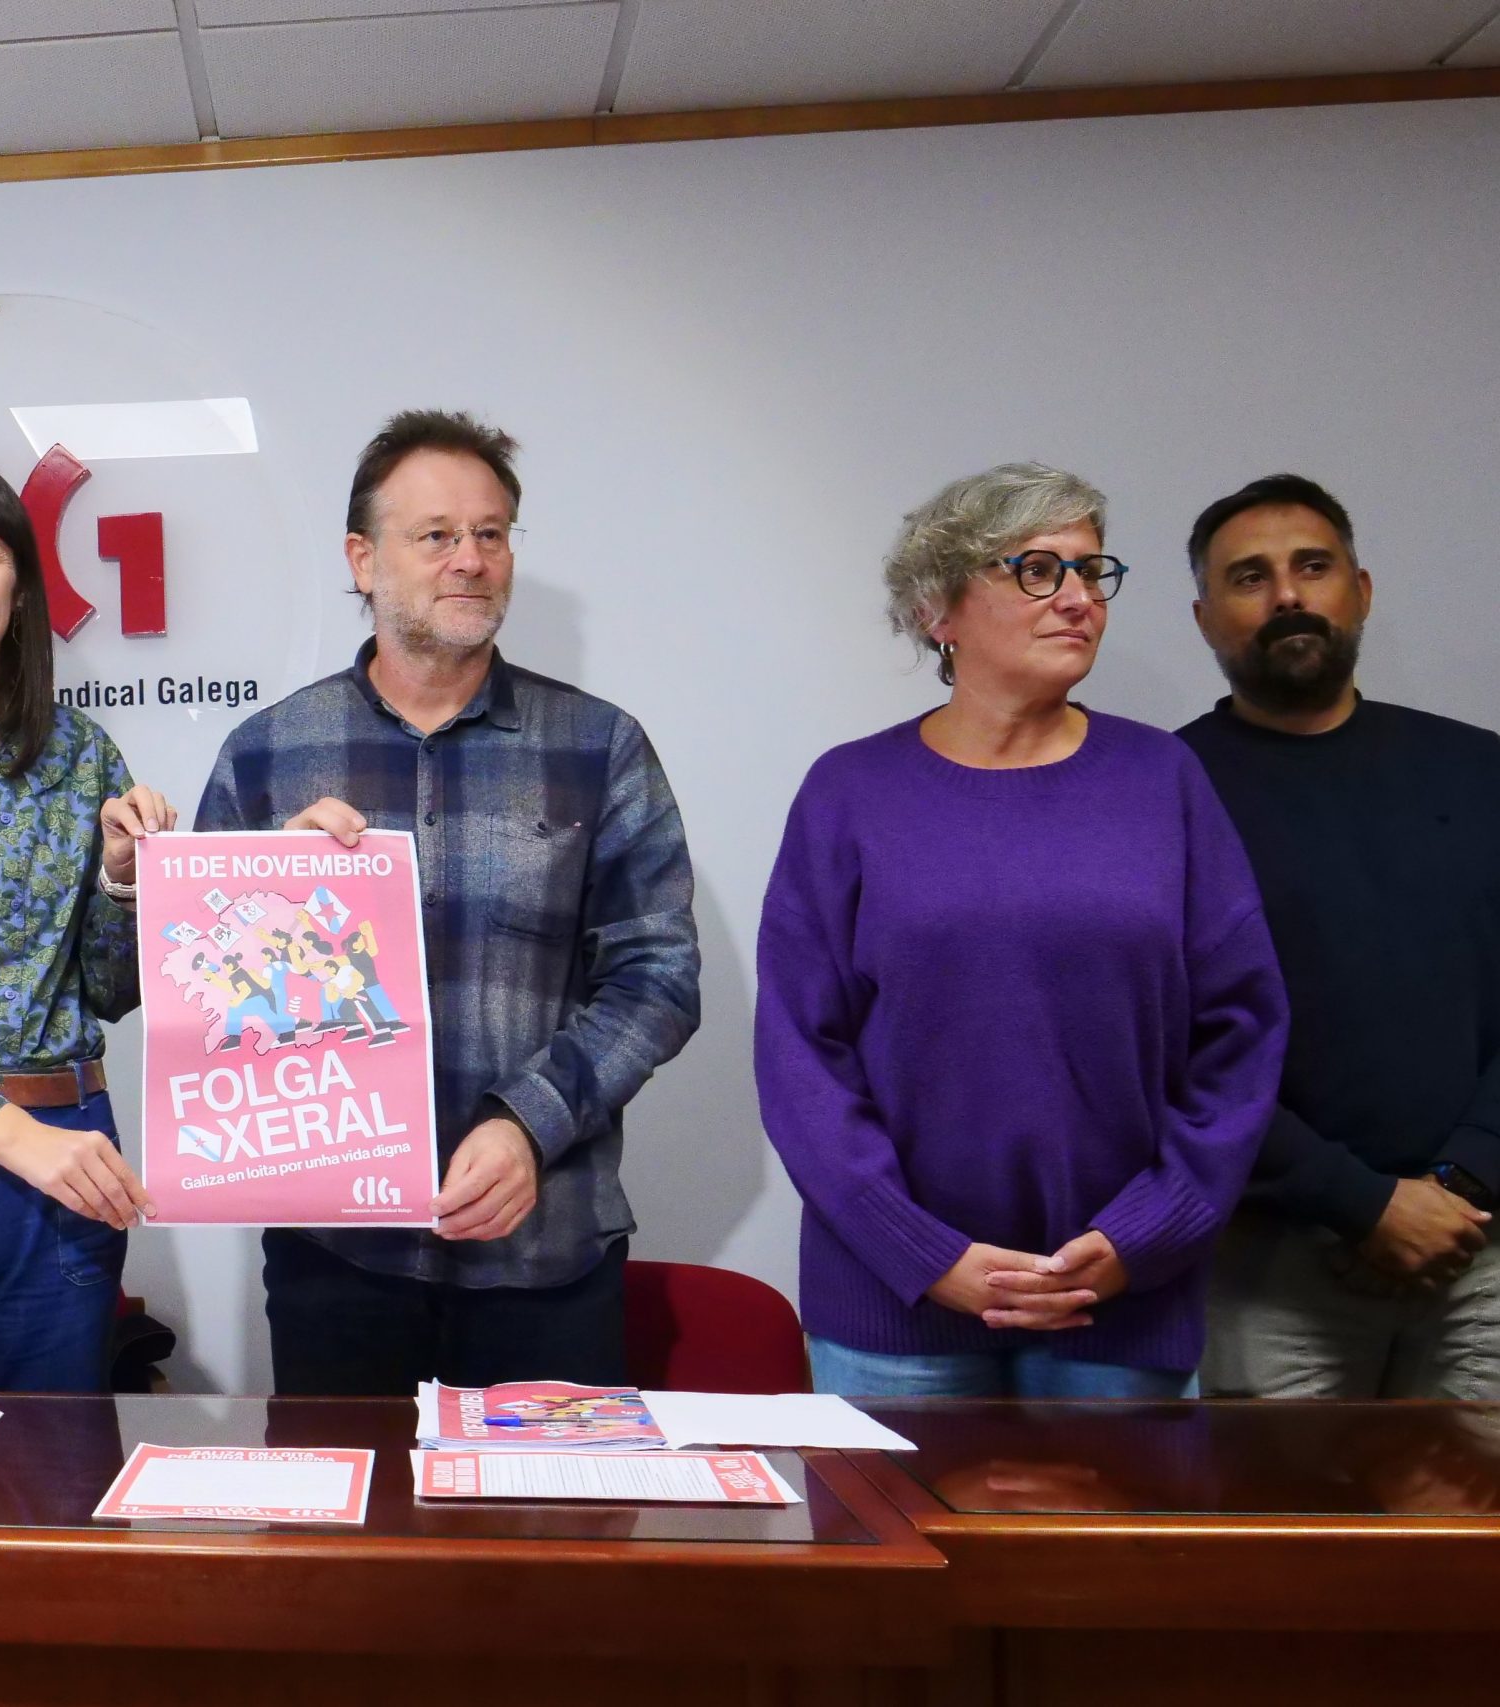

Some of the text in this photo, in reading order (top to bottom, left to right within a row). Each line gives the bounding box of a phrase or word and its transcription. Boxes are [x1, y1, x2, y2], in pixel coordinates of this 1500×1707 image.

[59, 678, 145, 708] ndical
[157, 676, 258, 707] Galega
[160, 853, 393, 878] 11 DE NOVEMBRO
[169, 1049, 356, 1120] FOLGA
[216, 1091, 408, 1163] XERAL
[181, 1142, 412, 1191] Galiza en loita por unha vida digna
[352, 1176, 401, 1206] CIG
